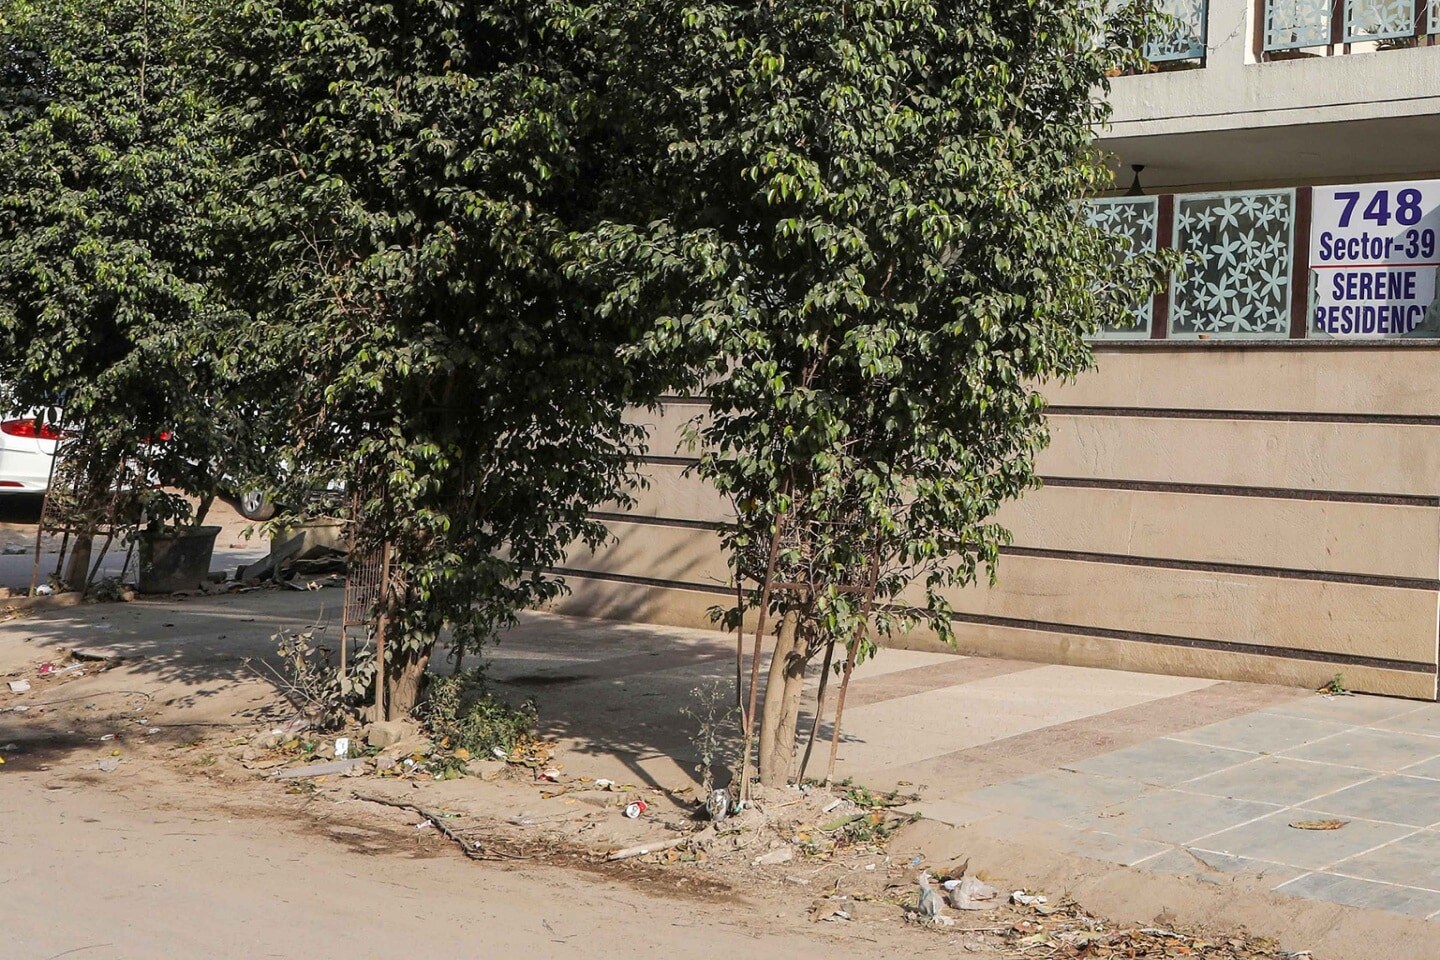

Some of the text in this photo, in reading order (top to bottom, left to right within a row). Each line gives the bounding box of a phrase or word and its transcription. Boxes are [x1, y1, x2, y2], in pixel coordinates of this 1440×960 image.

[1334, 188, 1422, 227] 748
[1319, 229, 1435, 261] Sector-39
[1332, 271, 1416, 301] SERENE
[1317, 304, 1427, 334] RESIDENC
